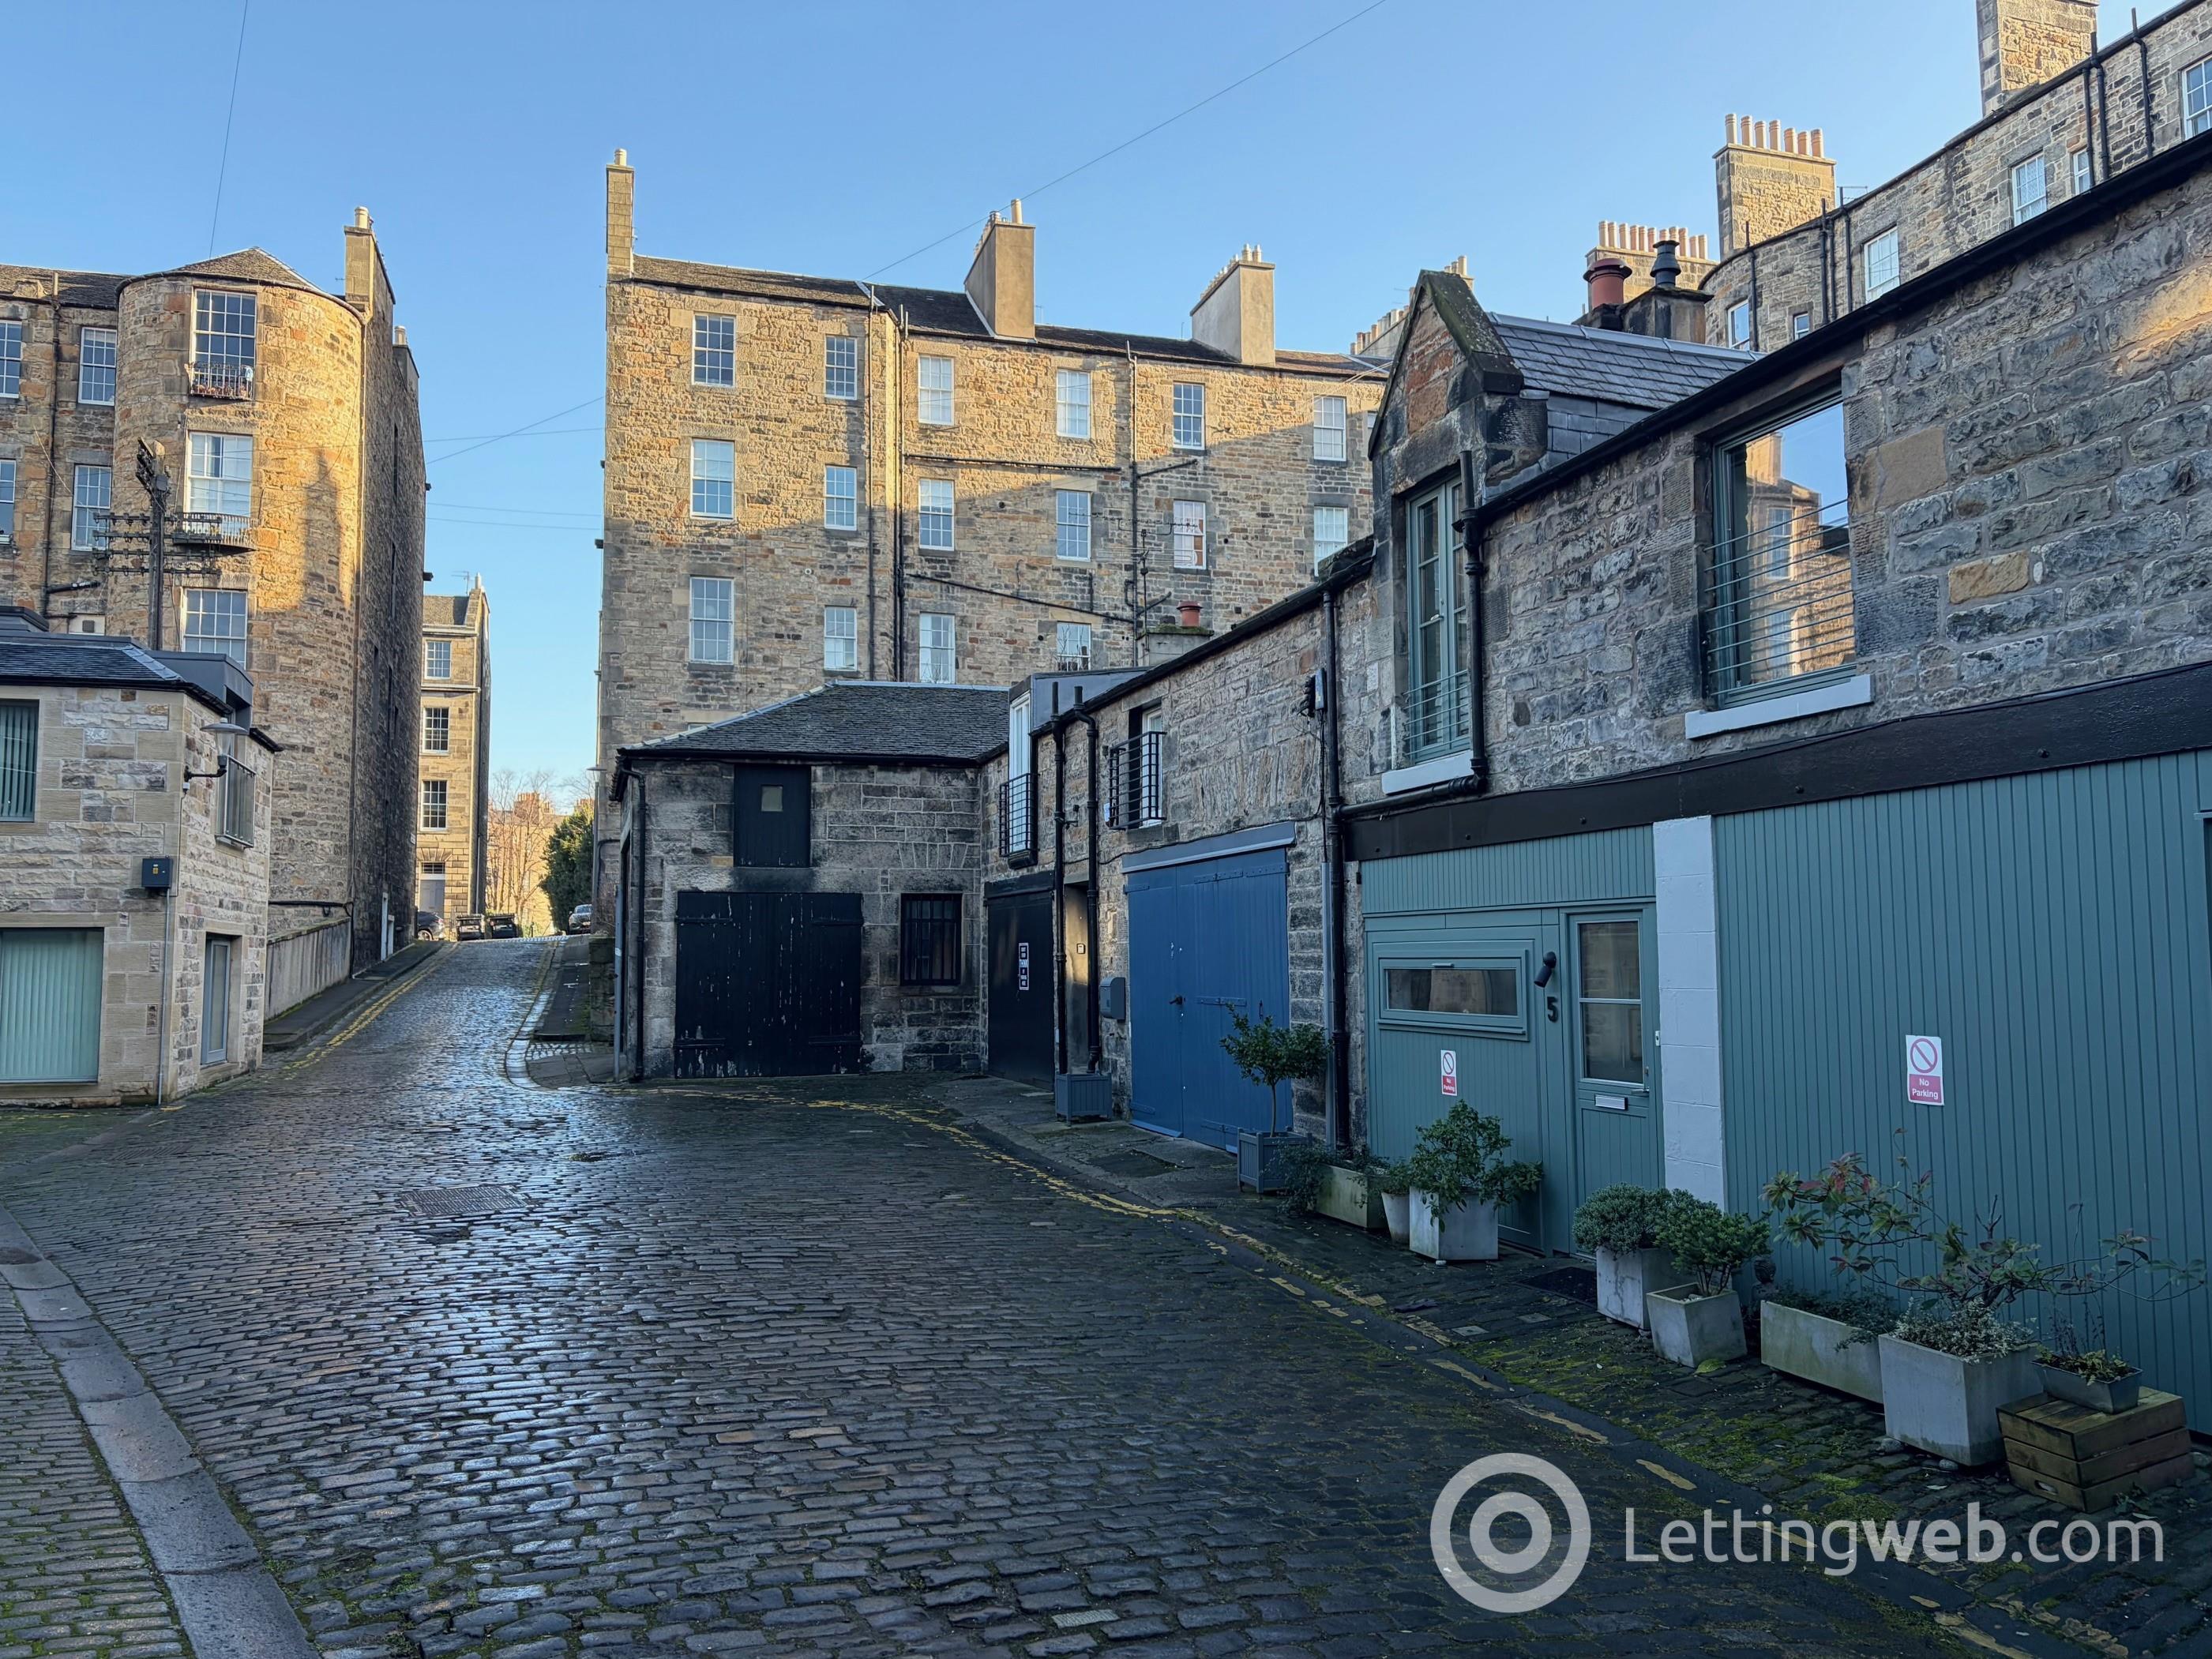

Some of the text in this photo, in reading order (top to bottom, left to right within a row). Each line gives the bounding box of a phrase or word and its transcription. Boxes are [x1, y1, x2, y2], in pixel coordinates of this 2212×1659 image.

[1547, 997, 1559, 1023] 5
[1919, 1078, 1929, 1087] No
[1912, 1088, 1939, 1100] Parking
